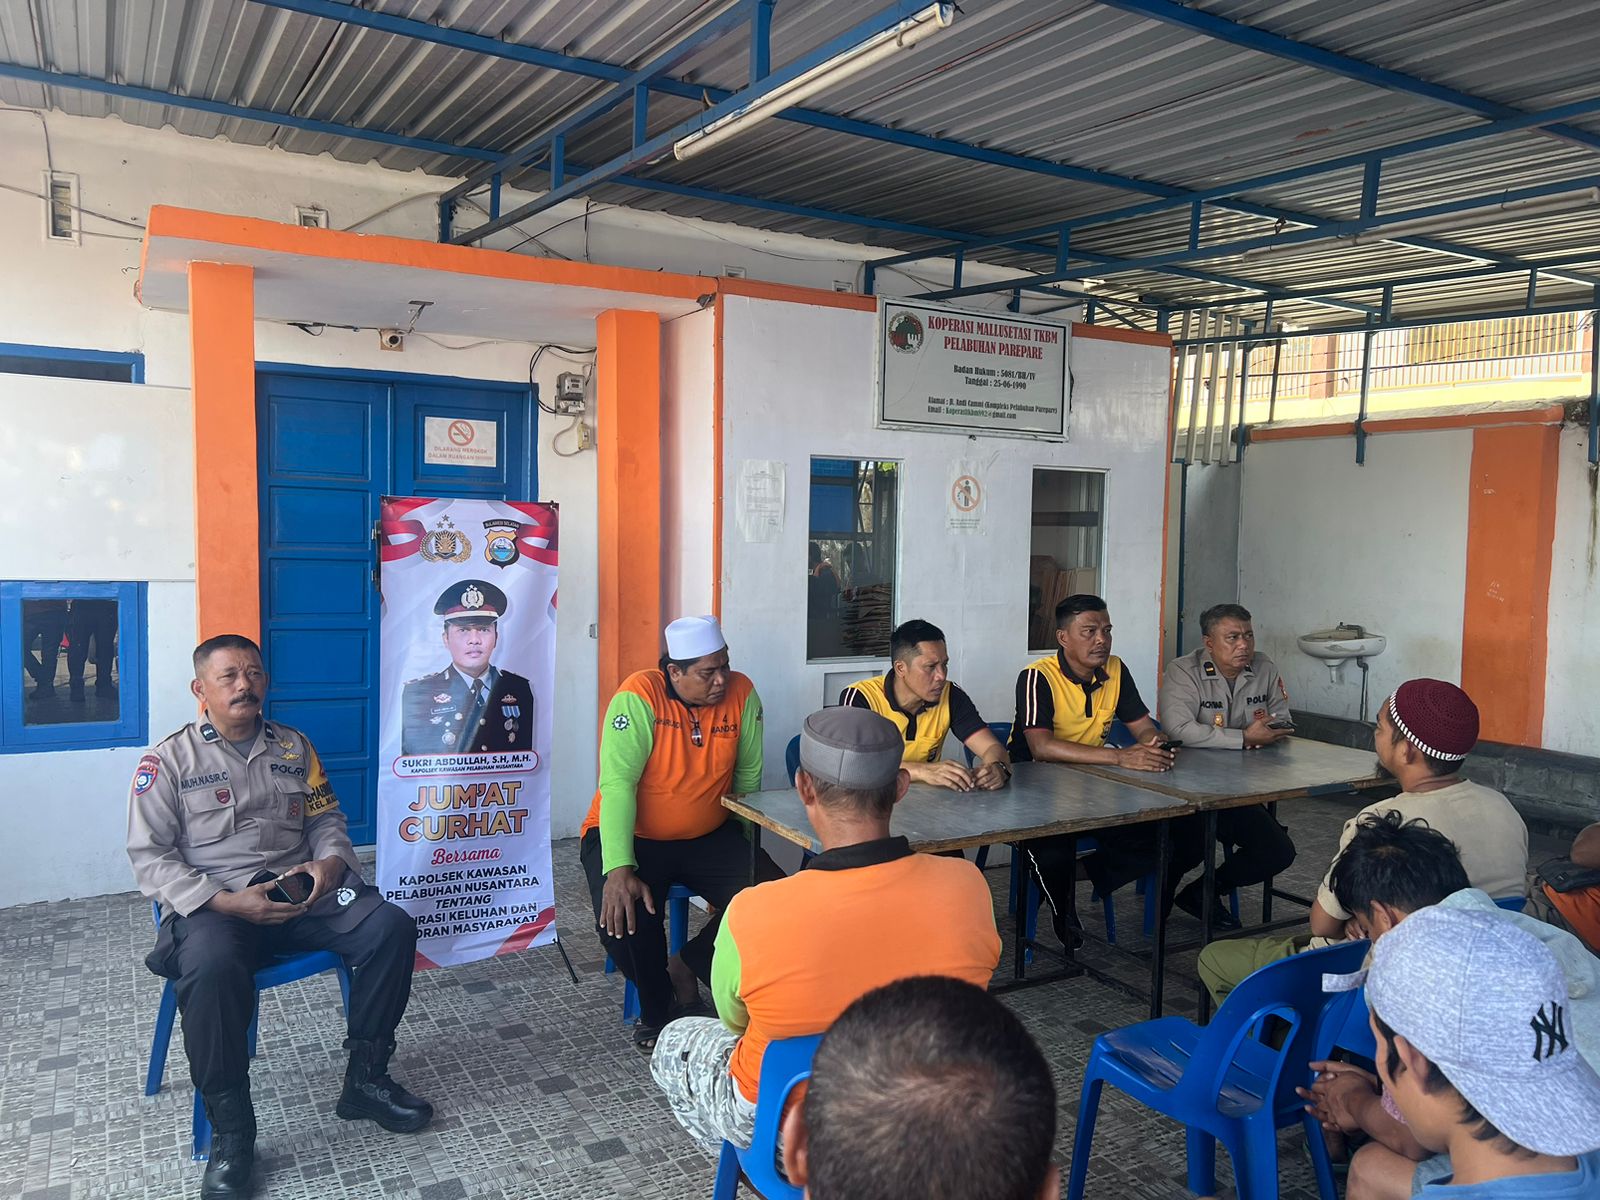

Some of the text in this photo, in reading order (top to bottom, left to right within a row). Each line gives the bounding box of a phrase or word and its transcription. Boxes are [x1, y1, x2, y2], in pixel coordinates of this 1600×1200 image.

[928, 316, 1058, 344] KOPERASI MALLUSETASI TKBM
[944, 336, 996, 355] PELABUHAN
[998, 342, 1043, 360] PAREPARE
[953, 365, 973, 374] Badan
[975, 367, 996, 377] Hukum
[965, 376, 989, 387] Tanggal
[993, 380, 1027, 390] 25-06-1990
[928, 396, 945, 404] Alamat
[1010, 403, 1034, 412] Pelabuhan
[928, 405, 942, 413] Email
[722, 714, 728, 723] 4
[711, 723, 738, 733] MANDOR
[402, 759, 432, 768] SUKRI
[435, 756, 490, 766] ABDULLAH,
[512, 754, 531, 763] M.H.
[270, 763, 306, 777] POLRI
[408, 781, 522, 812] JUM'AT
[399, 809, 529, 843] CURHAT
[431, 848, 501, 866] Bersama
[399, 865, 527, 886] KAPOLSEK KAWASAN
[386, 876, 540, 901] PELABUHAN NUSANTARA
[435, 894, 492, 910] TENTANG
[415, 902, 538, 925] IRASI KELUHAN DAN
[416, 915, 538, 939] ORAN MASYARAKAT
